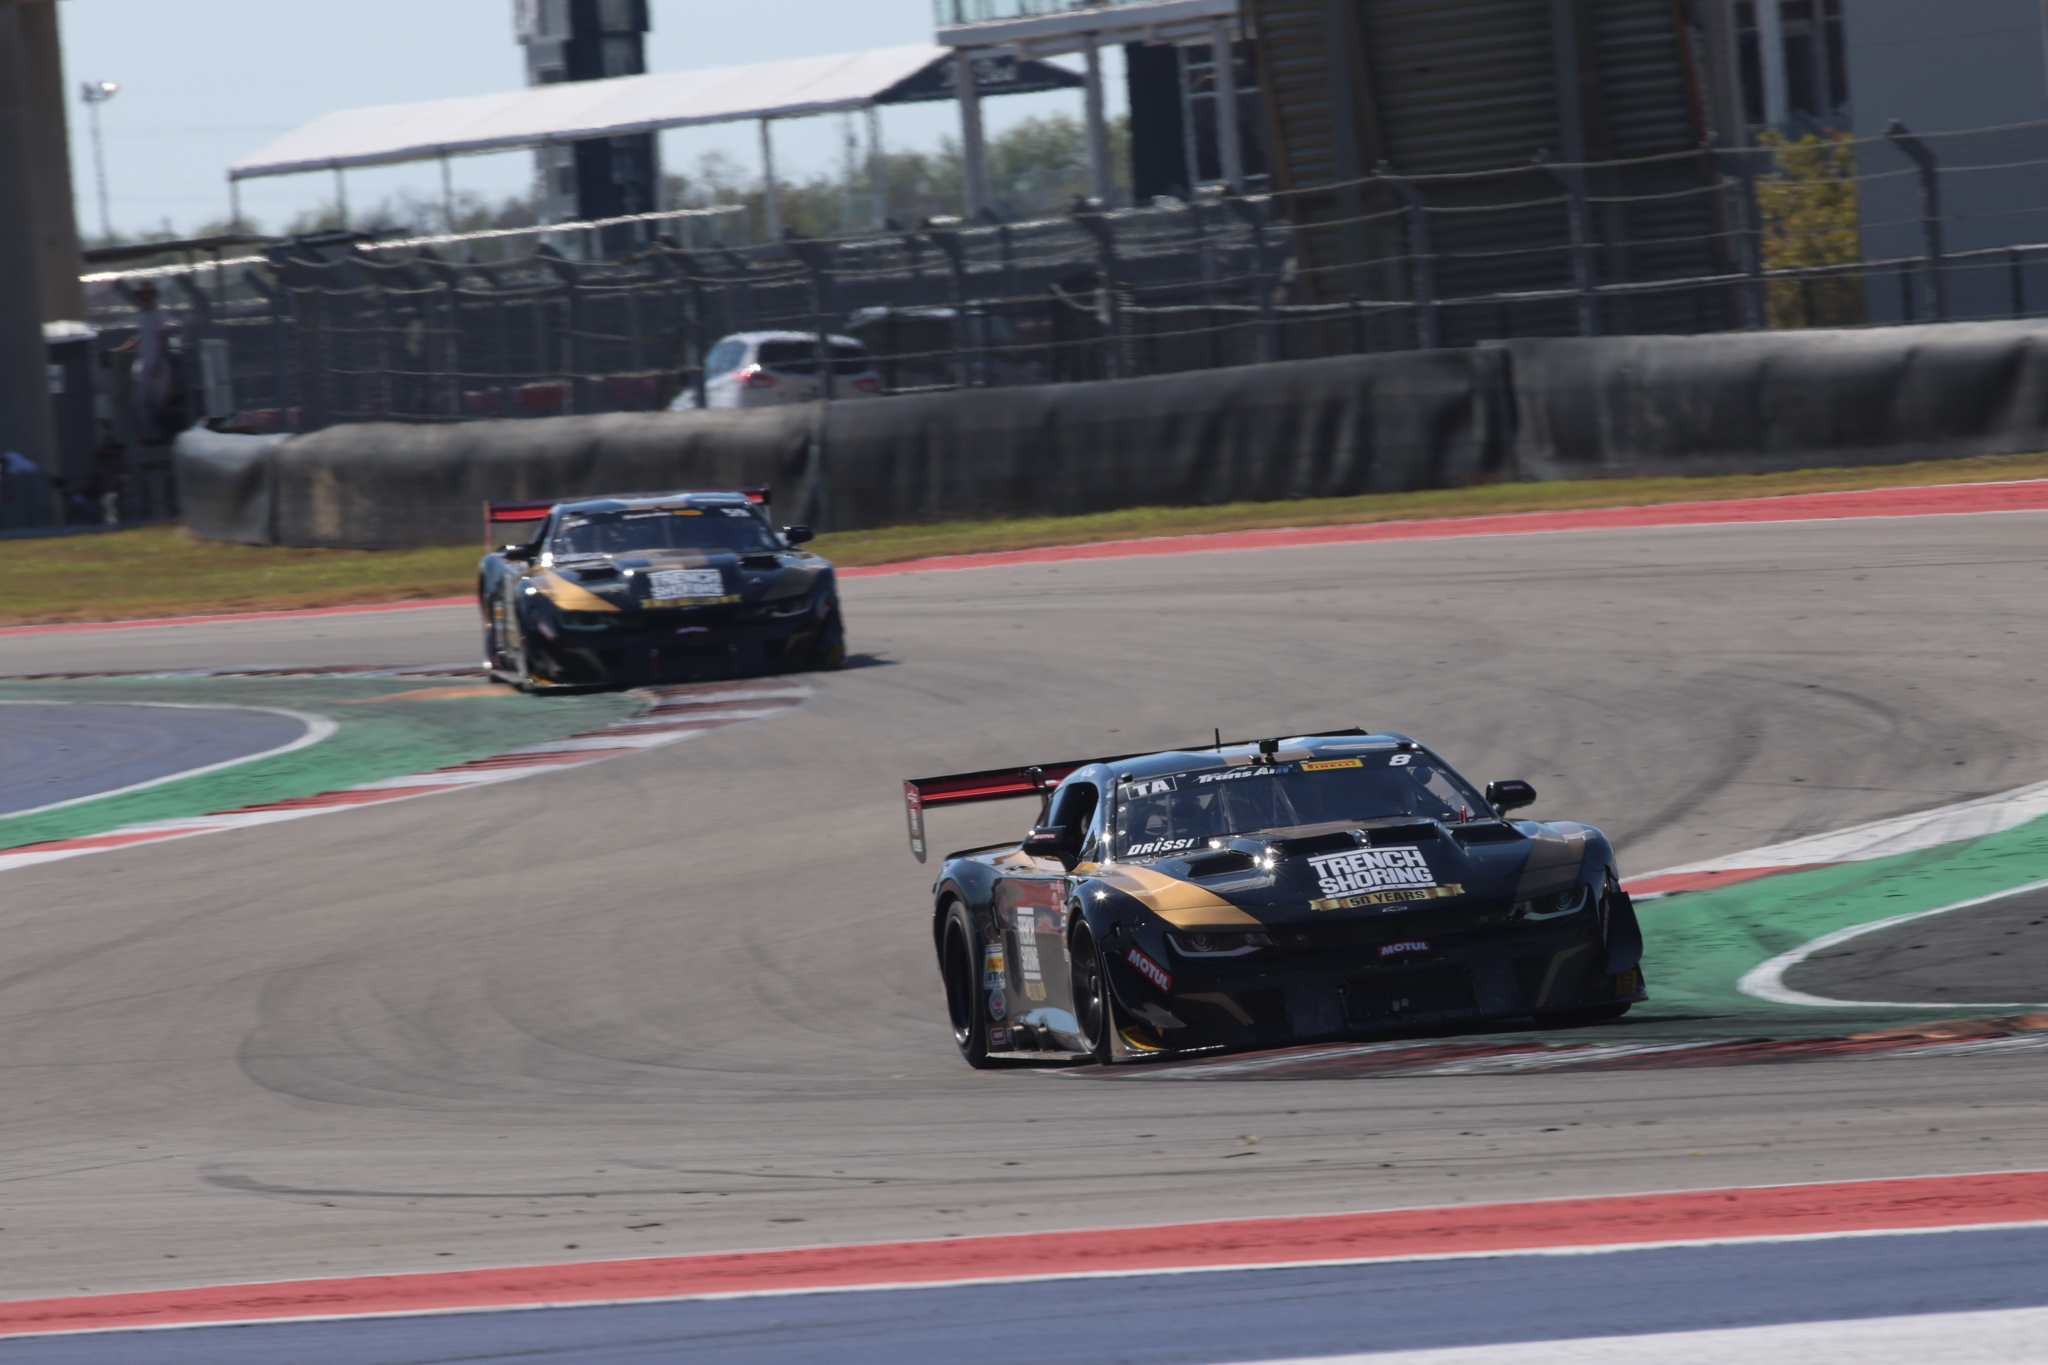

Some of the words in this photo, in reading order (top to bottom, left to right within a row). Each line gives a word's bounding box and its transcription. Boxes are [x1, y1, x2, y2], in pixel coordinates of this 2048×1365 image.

[1307, 760, 1358, 770] PIRELLI
[1389, 754, 1411, 766] 8
[1198, 771, 1253, 784] Trans
[1133, 780, 1170, 796] TA
[1310, 851, 1427, 879] TRENCH
[1318, 867, 1433, 894] SHORING
[1350, 897, 1371, 907] 50
[1374, 891, 1425, 903] YEARS
[1381, 942, 1428, 956] MOTUL
[1128, 949, 1169, 991] MOTUL
